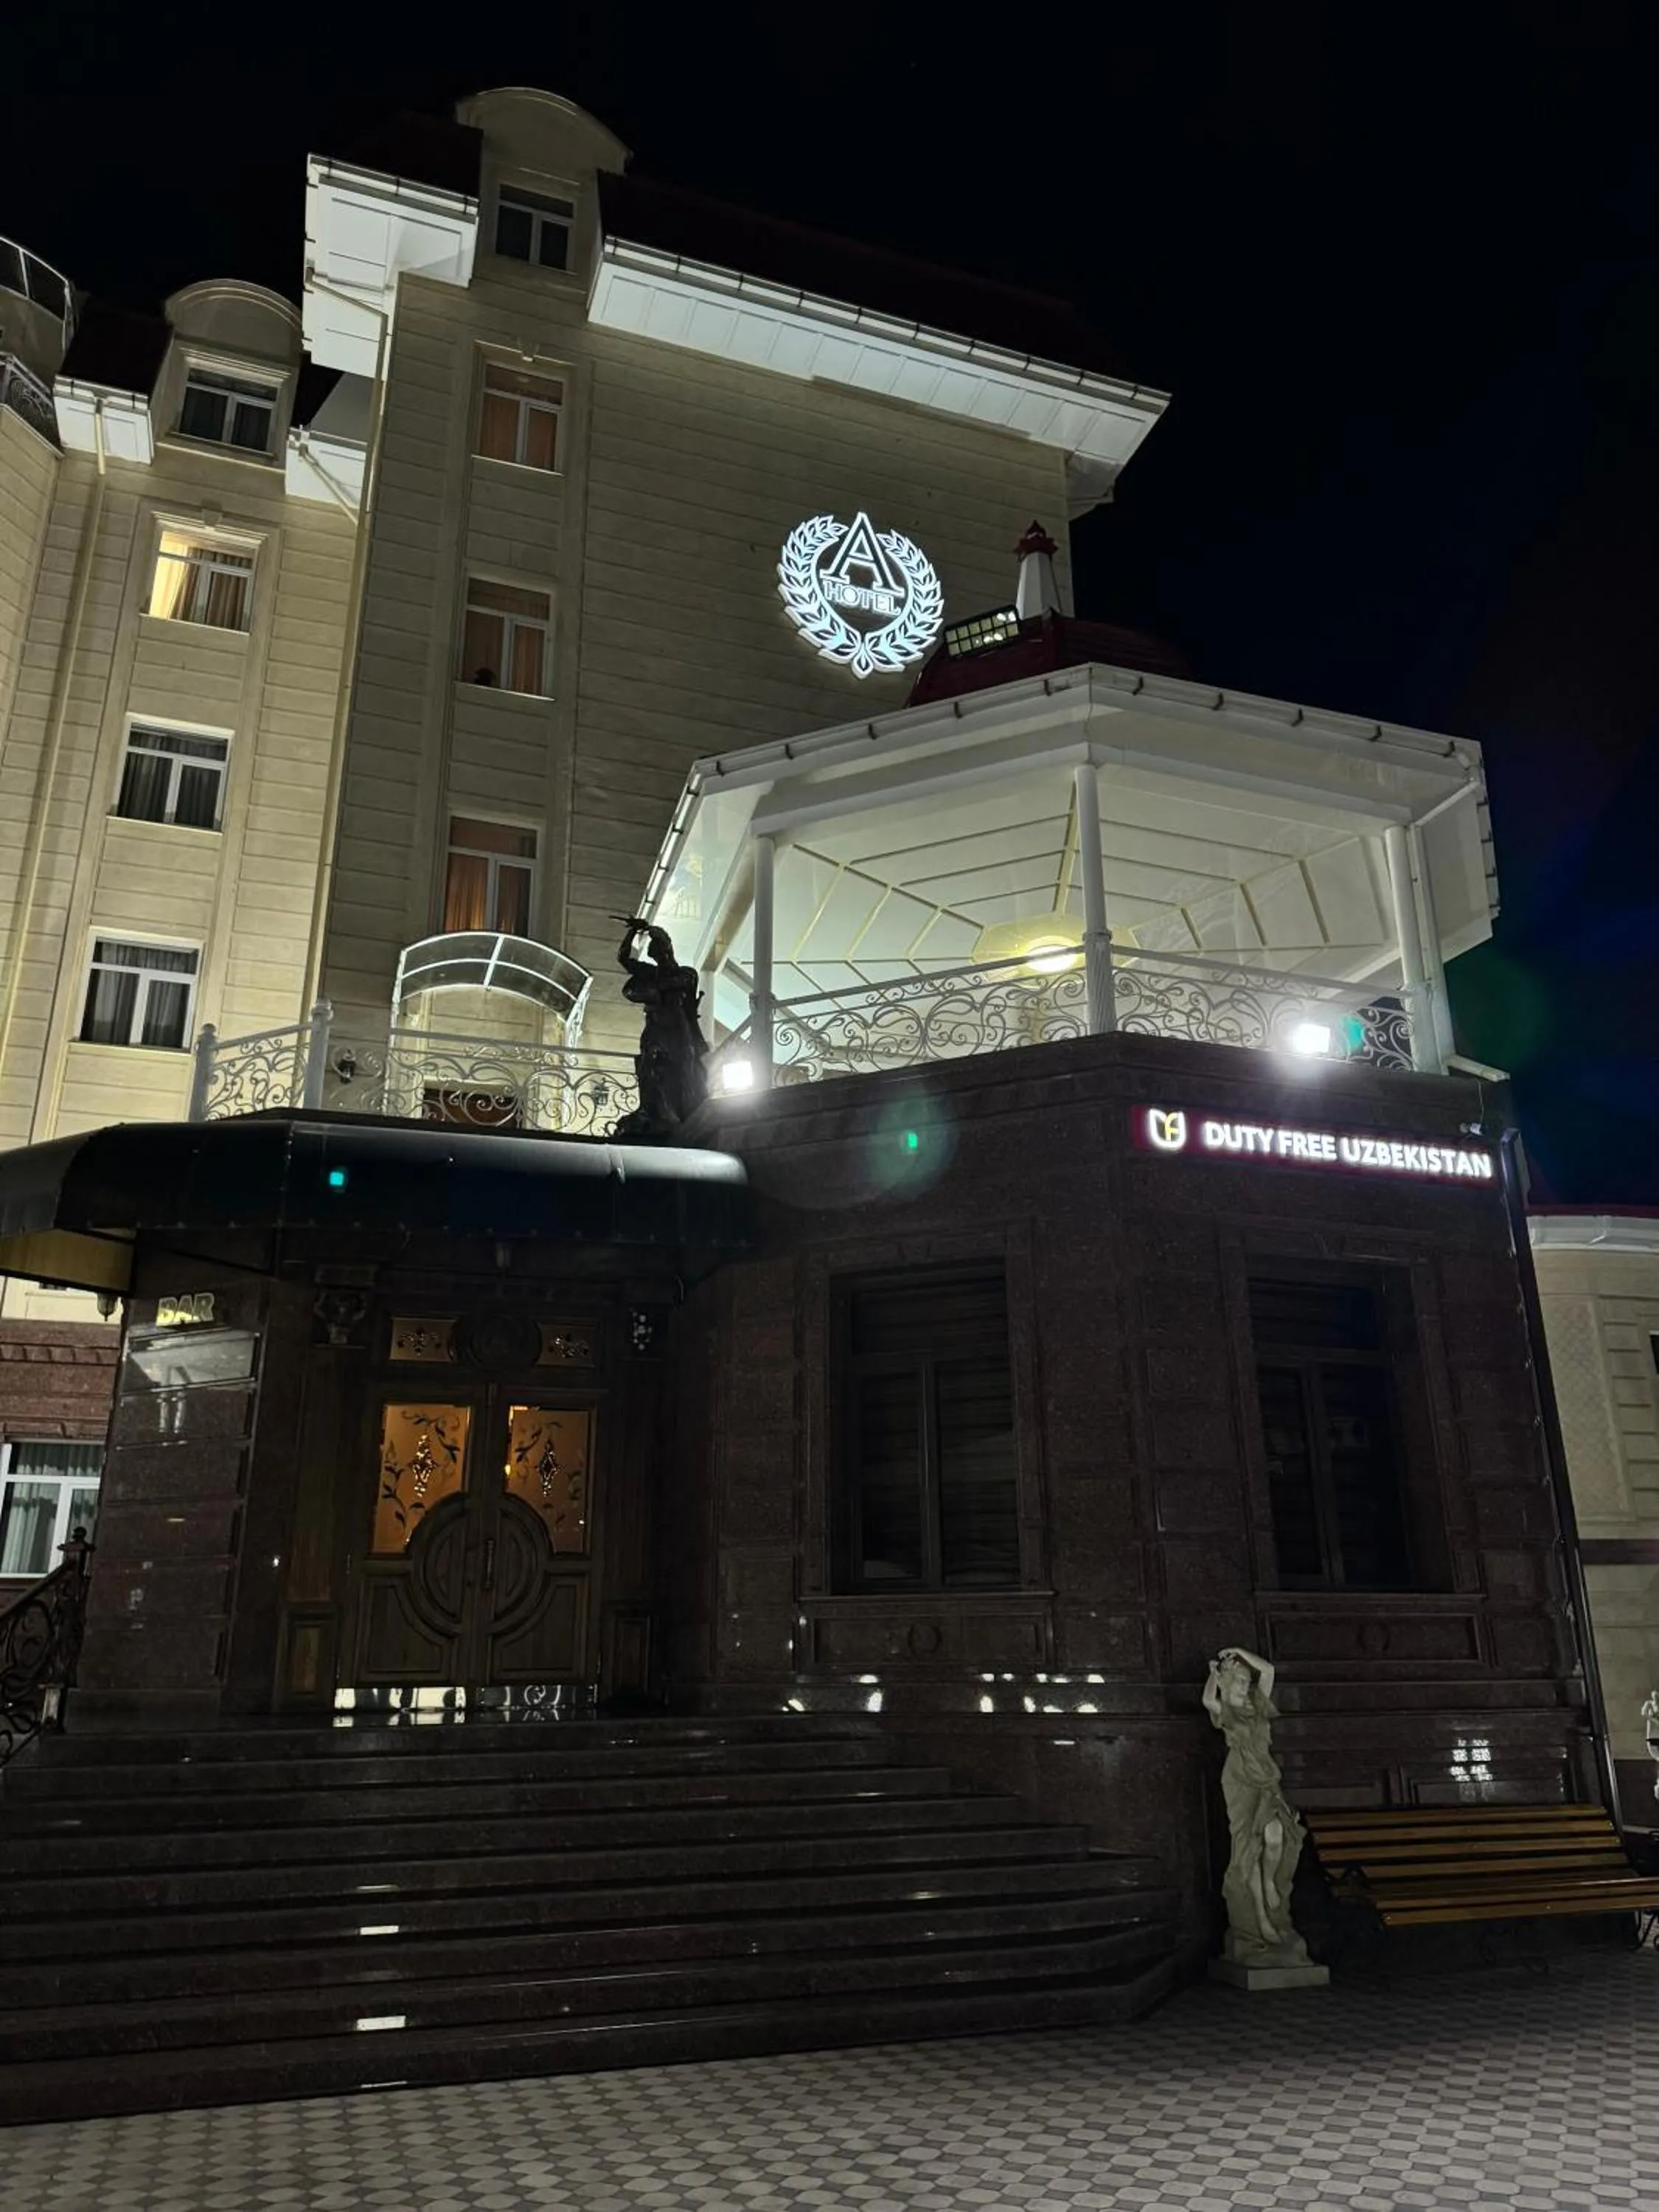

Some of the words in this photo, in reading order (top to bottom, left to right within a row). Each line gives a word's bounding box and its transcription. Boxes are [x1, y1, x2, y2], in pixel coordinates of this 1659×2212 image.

[819, 512, 904, 597] A
[823, 580, 902, 616] HOTEL
[1203, 1120, 1275, 1153] DUTY
[1275, 1130, 1338, 1160] FREE
[1340, 1136, 1493, 1179] UZBEKISTAN
[156, 1293, 215, 1326] BAR
